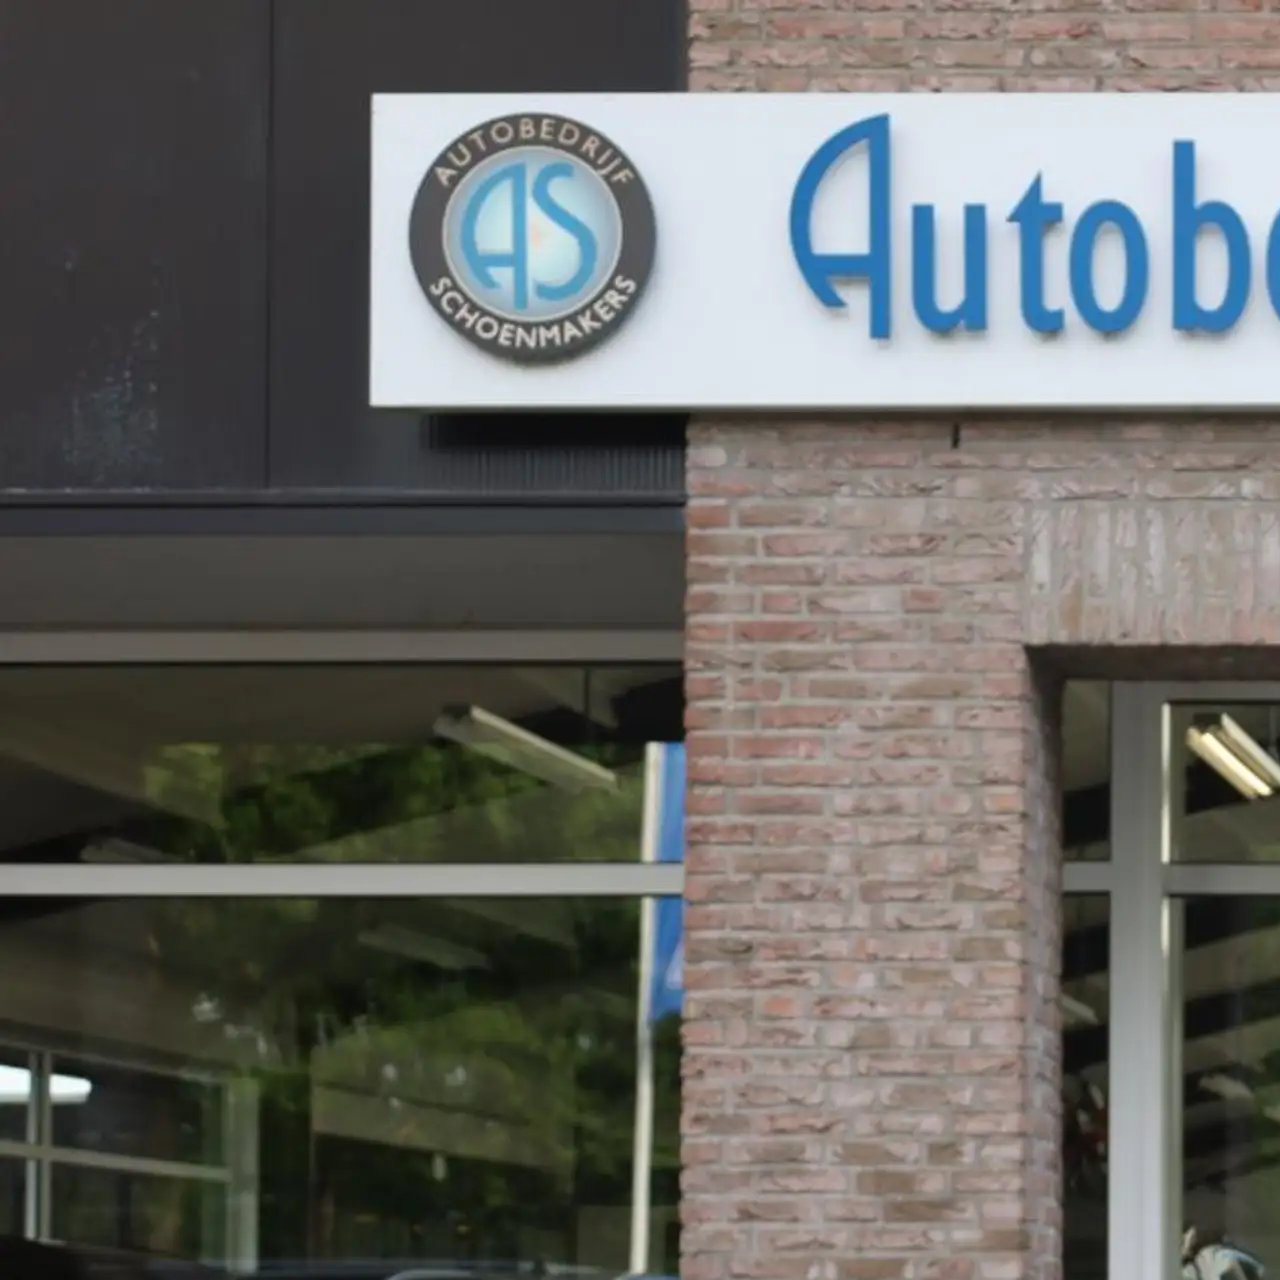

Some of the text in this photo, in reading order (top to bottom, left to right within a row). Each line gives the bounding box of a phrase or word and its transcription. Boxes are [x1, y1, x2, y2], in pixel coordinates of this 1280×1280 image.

[434, 117, 634, 188] AUTOBEDRIJF
[460, 162, 597, 310] AS
[429, 275, 637, 350] SCHOENMAKERS
